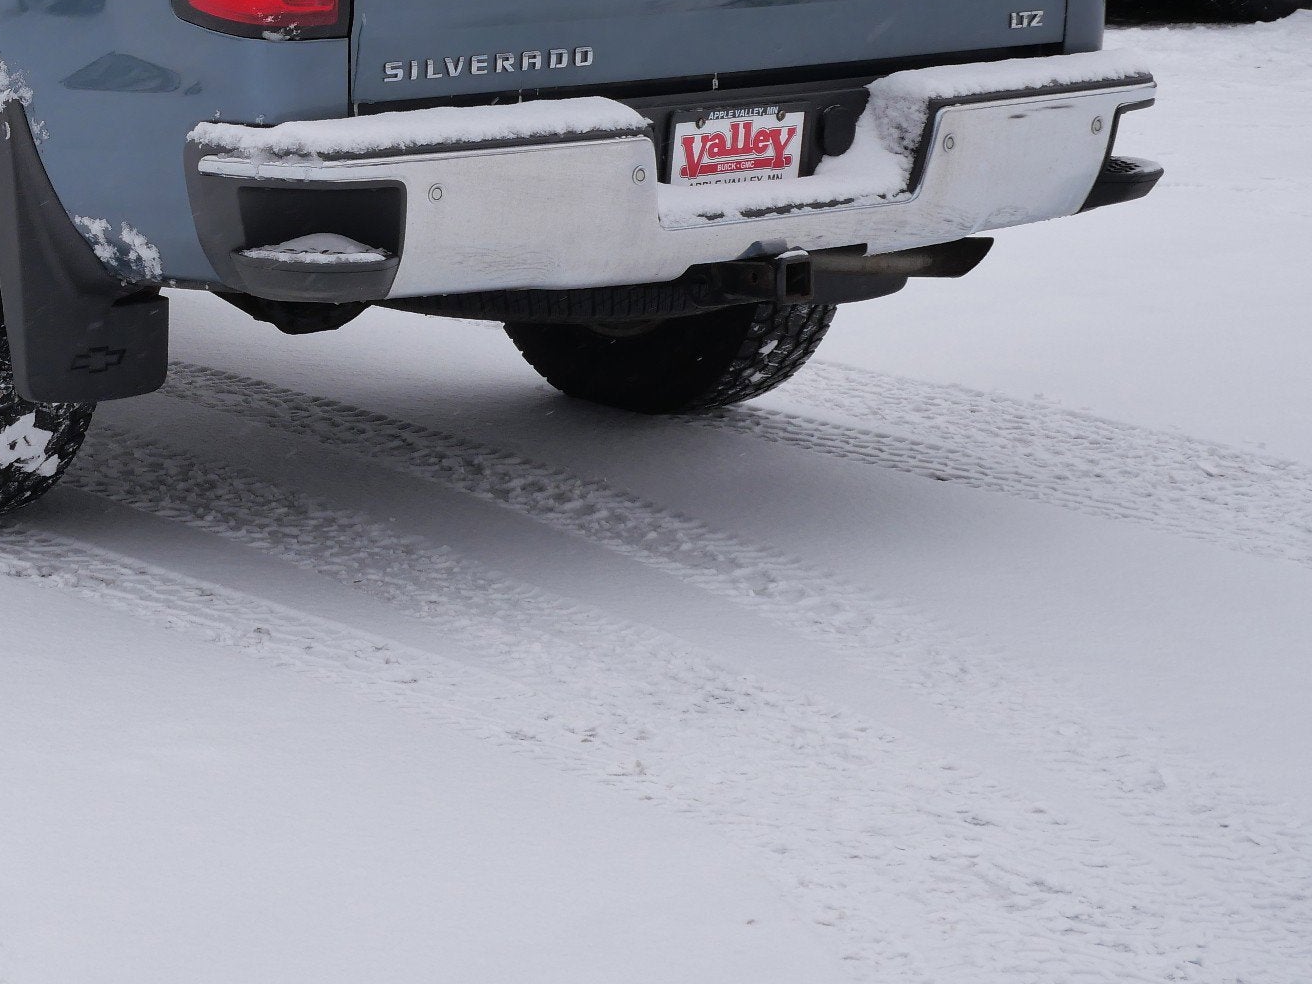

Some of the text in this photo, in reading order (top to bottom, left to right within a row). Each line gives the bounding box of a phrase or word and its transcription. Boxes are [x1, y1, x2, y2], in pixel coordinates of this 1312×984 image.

[1009, 10, 1044, 29] LTZ
[384, 46, 594, 82] SILVERADO
[708, 111, 734, 120] APPLE
[766, 106, 779, 115] MN
[681, 120, 797, 180] Valley
[717, 160, 755, 172] BUICK GMC
